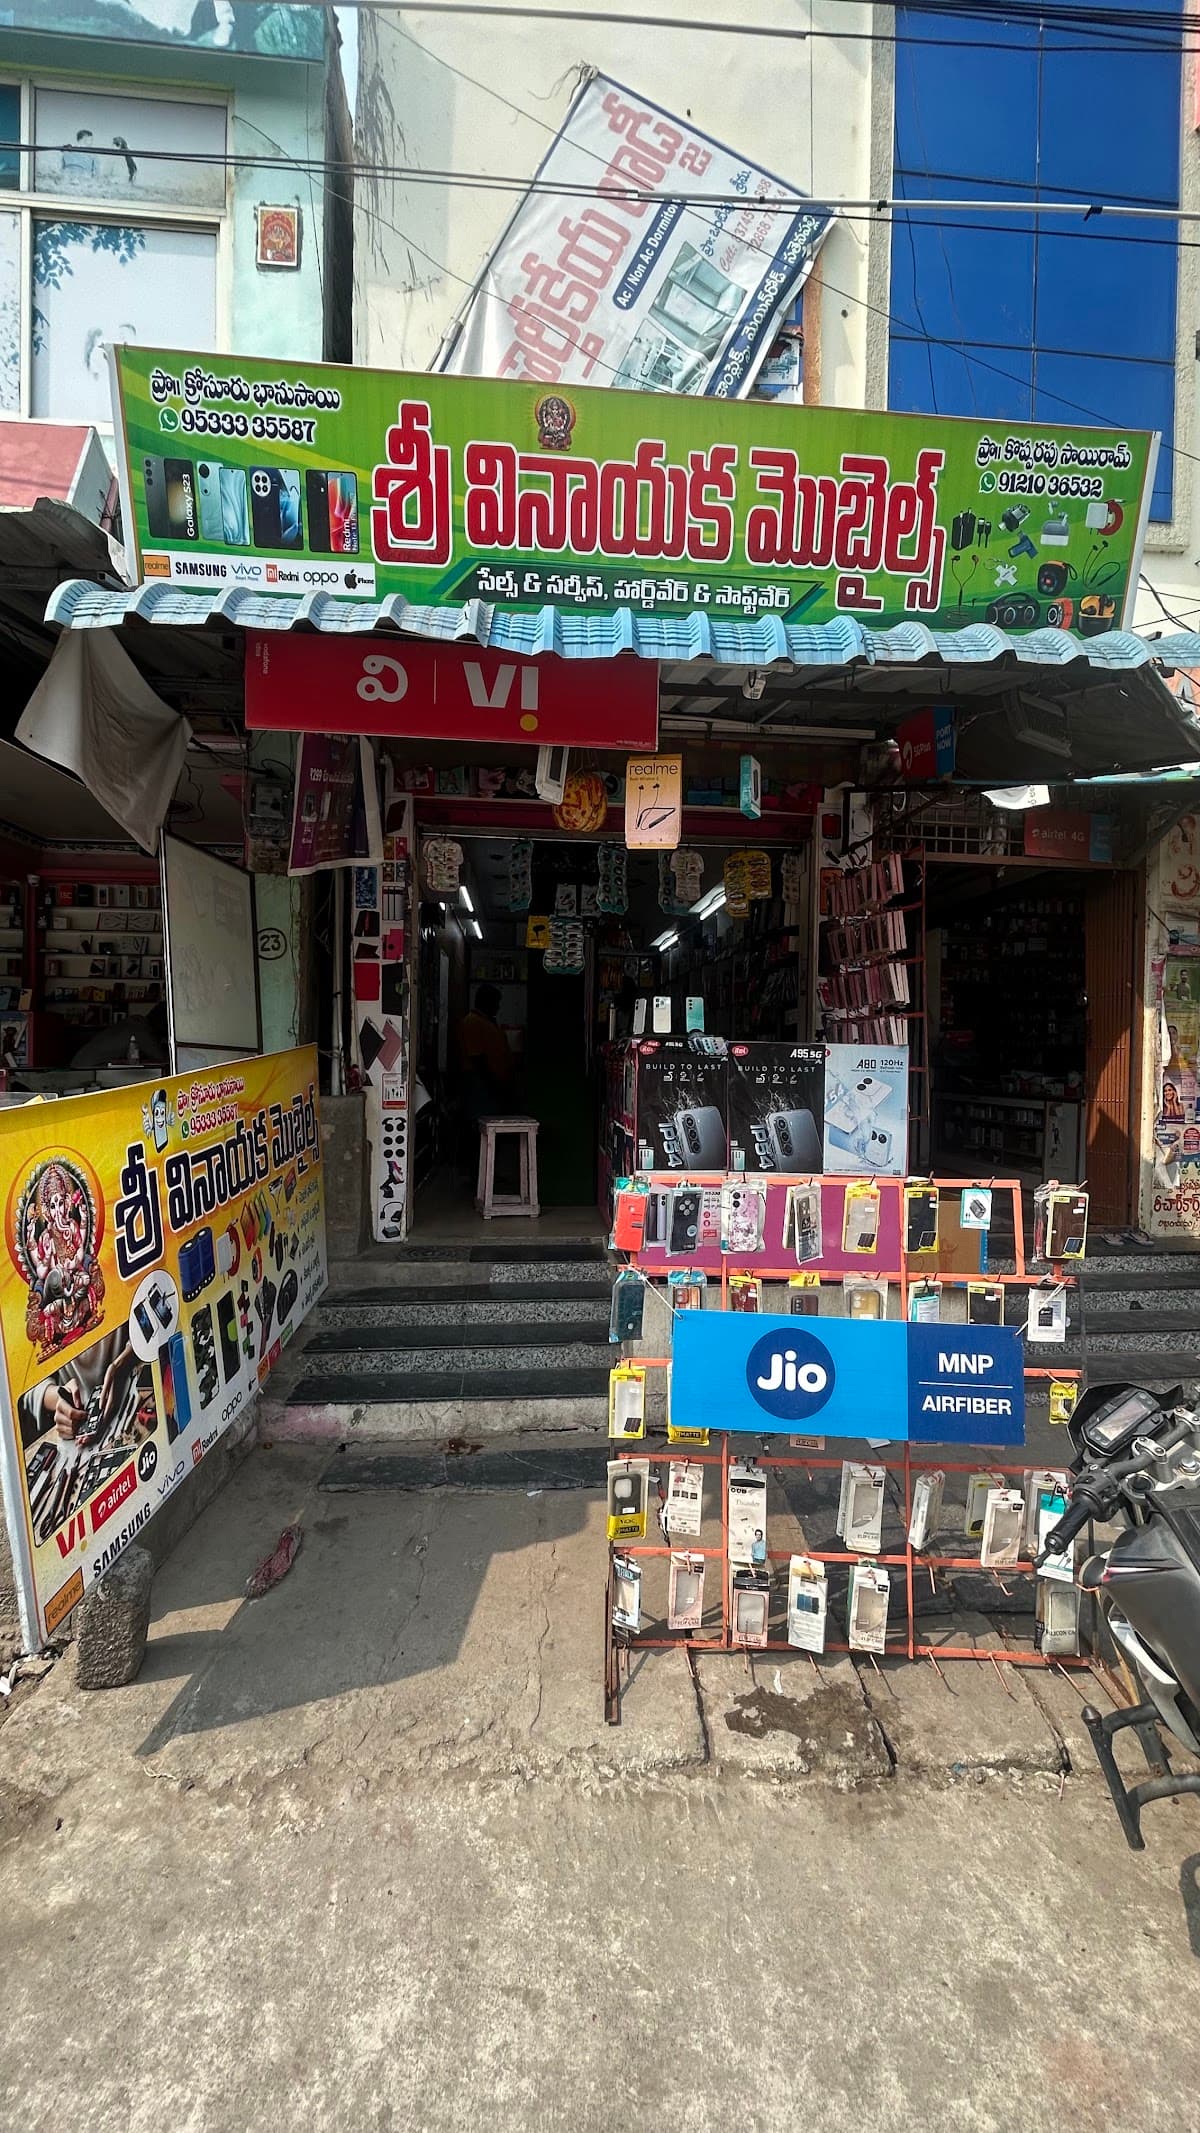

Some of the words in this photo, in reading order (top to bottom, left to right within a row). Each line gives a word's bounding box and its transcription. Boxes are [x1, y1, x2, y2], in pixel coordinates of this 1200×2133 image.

[616, 290, 632, 307] Ac
[627, 263, 647, 287] Non
[640, 248, 655, 265] Ac
[252, 378, 341, 411] భానుసాయి
[181, 408, 249, 437] 95333
[252, 413, 318, 443] 35587
[1061, 442, 1132, 469] సాయిరామ్
[183, 473, 193, 494] S23
[998, 473, 1045, 495] 91210
[1048, 475, 1103, 498] 36532
[186, 495, 195, 538] Galaxy
[373, 401, 451, 565] శ్రీ
[465, 440, 737, 562] వినాయక
[747, 447, 947, 613] మొబైల్స్
[343, 516, 353, 552] Redmi
[144, 560, 169, 572] realme
[175, 560, 227, 578] SAMSUNG
[230, 561, 262, 577] vivo
[278, 570, 299, 584] Redmi
[303, 569, 339, 587] oppo
[477, 565, 518, 599] సేల్స్
[523, 573, 542, 590] &
[693, 583, 712, 602] &
[356, 654, 409, 703] వి
[936, 737, 952, 753] NOW
[629, 762, 679, 776] realme
[1040, 828, 1066, 841] airtel
[1071, 830, 1086, 842] 4G
[258, 932, 282, 951] 23
[790, 1049, 809, 1059] A95
[809, 1050, 823, 1059] 5G
[856, 1058, 877, 1069] A80
[879, 1059, 904, 1067] 120Hz
[190, 1111, 219, 1135] 95333
[217, 1103, 240, 1126] 35587
[116, 1142, 164, 1281] శ్రీ
[165, 1110, 270, 1233] వినాయక
[757, 1350, 828, 1393] Jio
[938, 1352, 994, 1375] MNP
[921, 1394, 1013, 1416] AIRFIBER
[139, 1450, 156, 1475] Jio
[93, 1502, 151, 1578] SAMSUNG
[157, 1459, 186, 1494] vivo
[202, 1425, 219, 1451] Redmi
[221, 1391, 243, 1422] oppo
[106, 1475, 132, 1510] airtel
